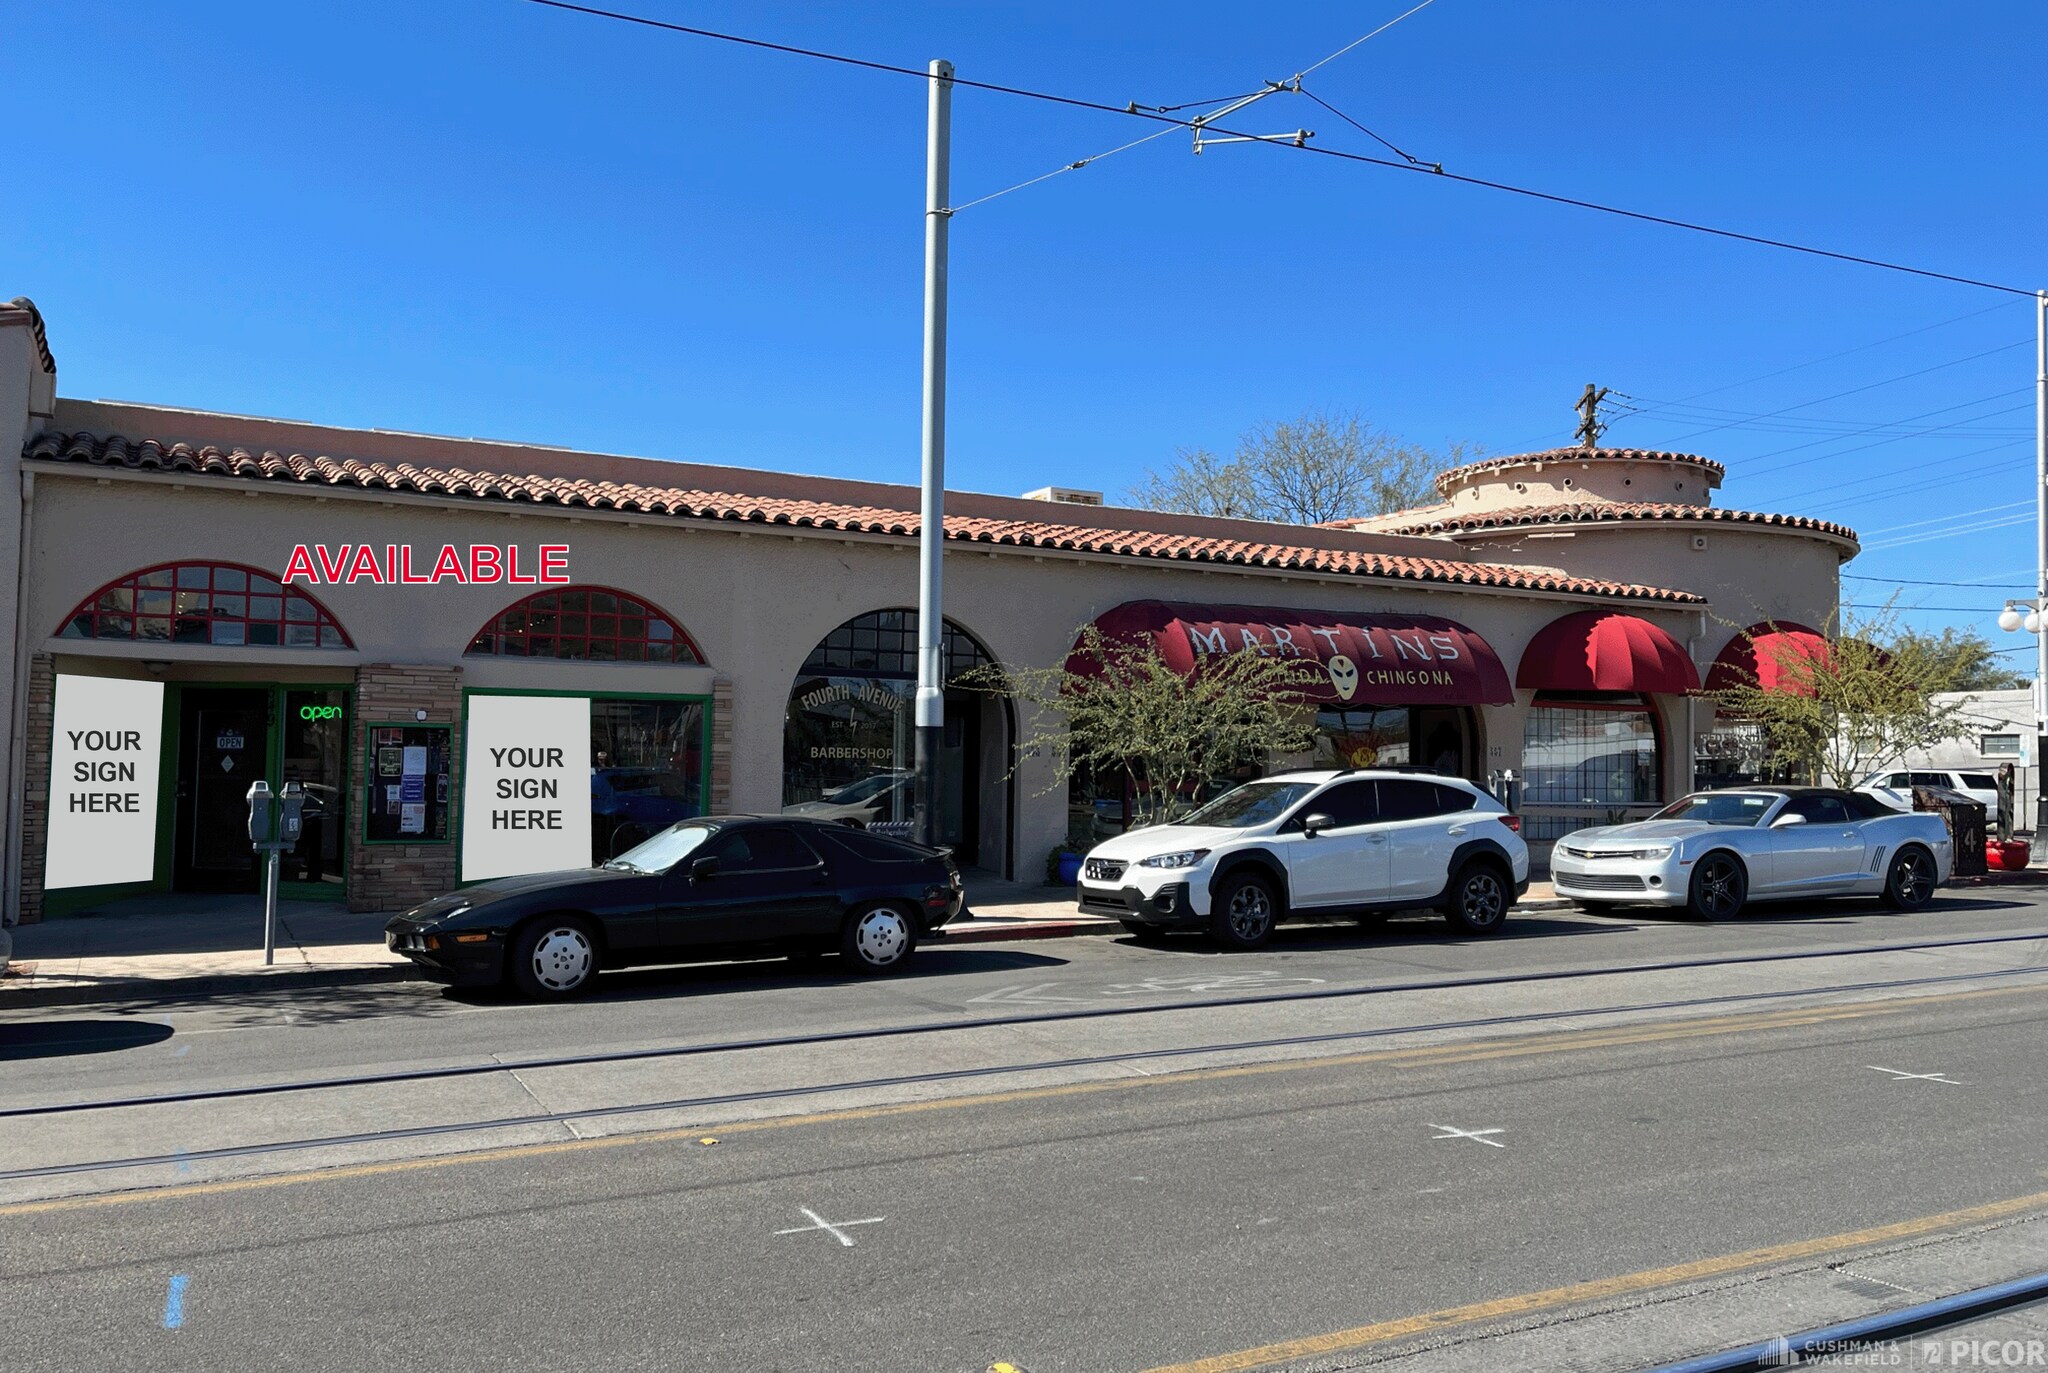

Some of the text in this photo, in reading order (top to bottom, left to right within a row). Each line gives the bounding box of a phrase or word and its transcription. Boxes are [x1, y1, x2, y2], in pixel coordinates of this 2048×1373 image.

[1366, 669, 1454, 686] CHINGONA
[801, 684, 905, 714] FOURTH AVENUE
[300, 706, 343, 722] open
[831, 721, 844, 729] EST
[219, 737, 242, 748] OPEN
[810, 746, 894, 759] BARBERSHOP
